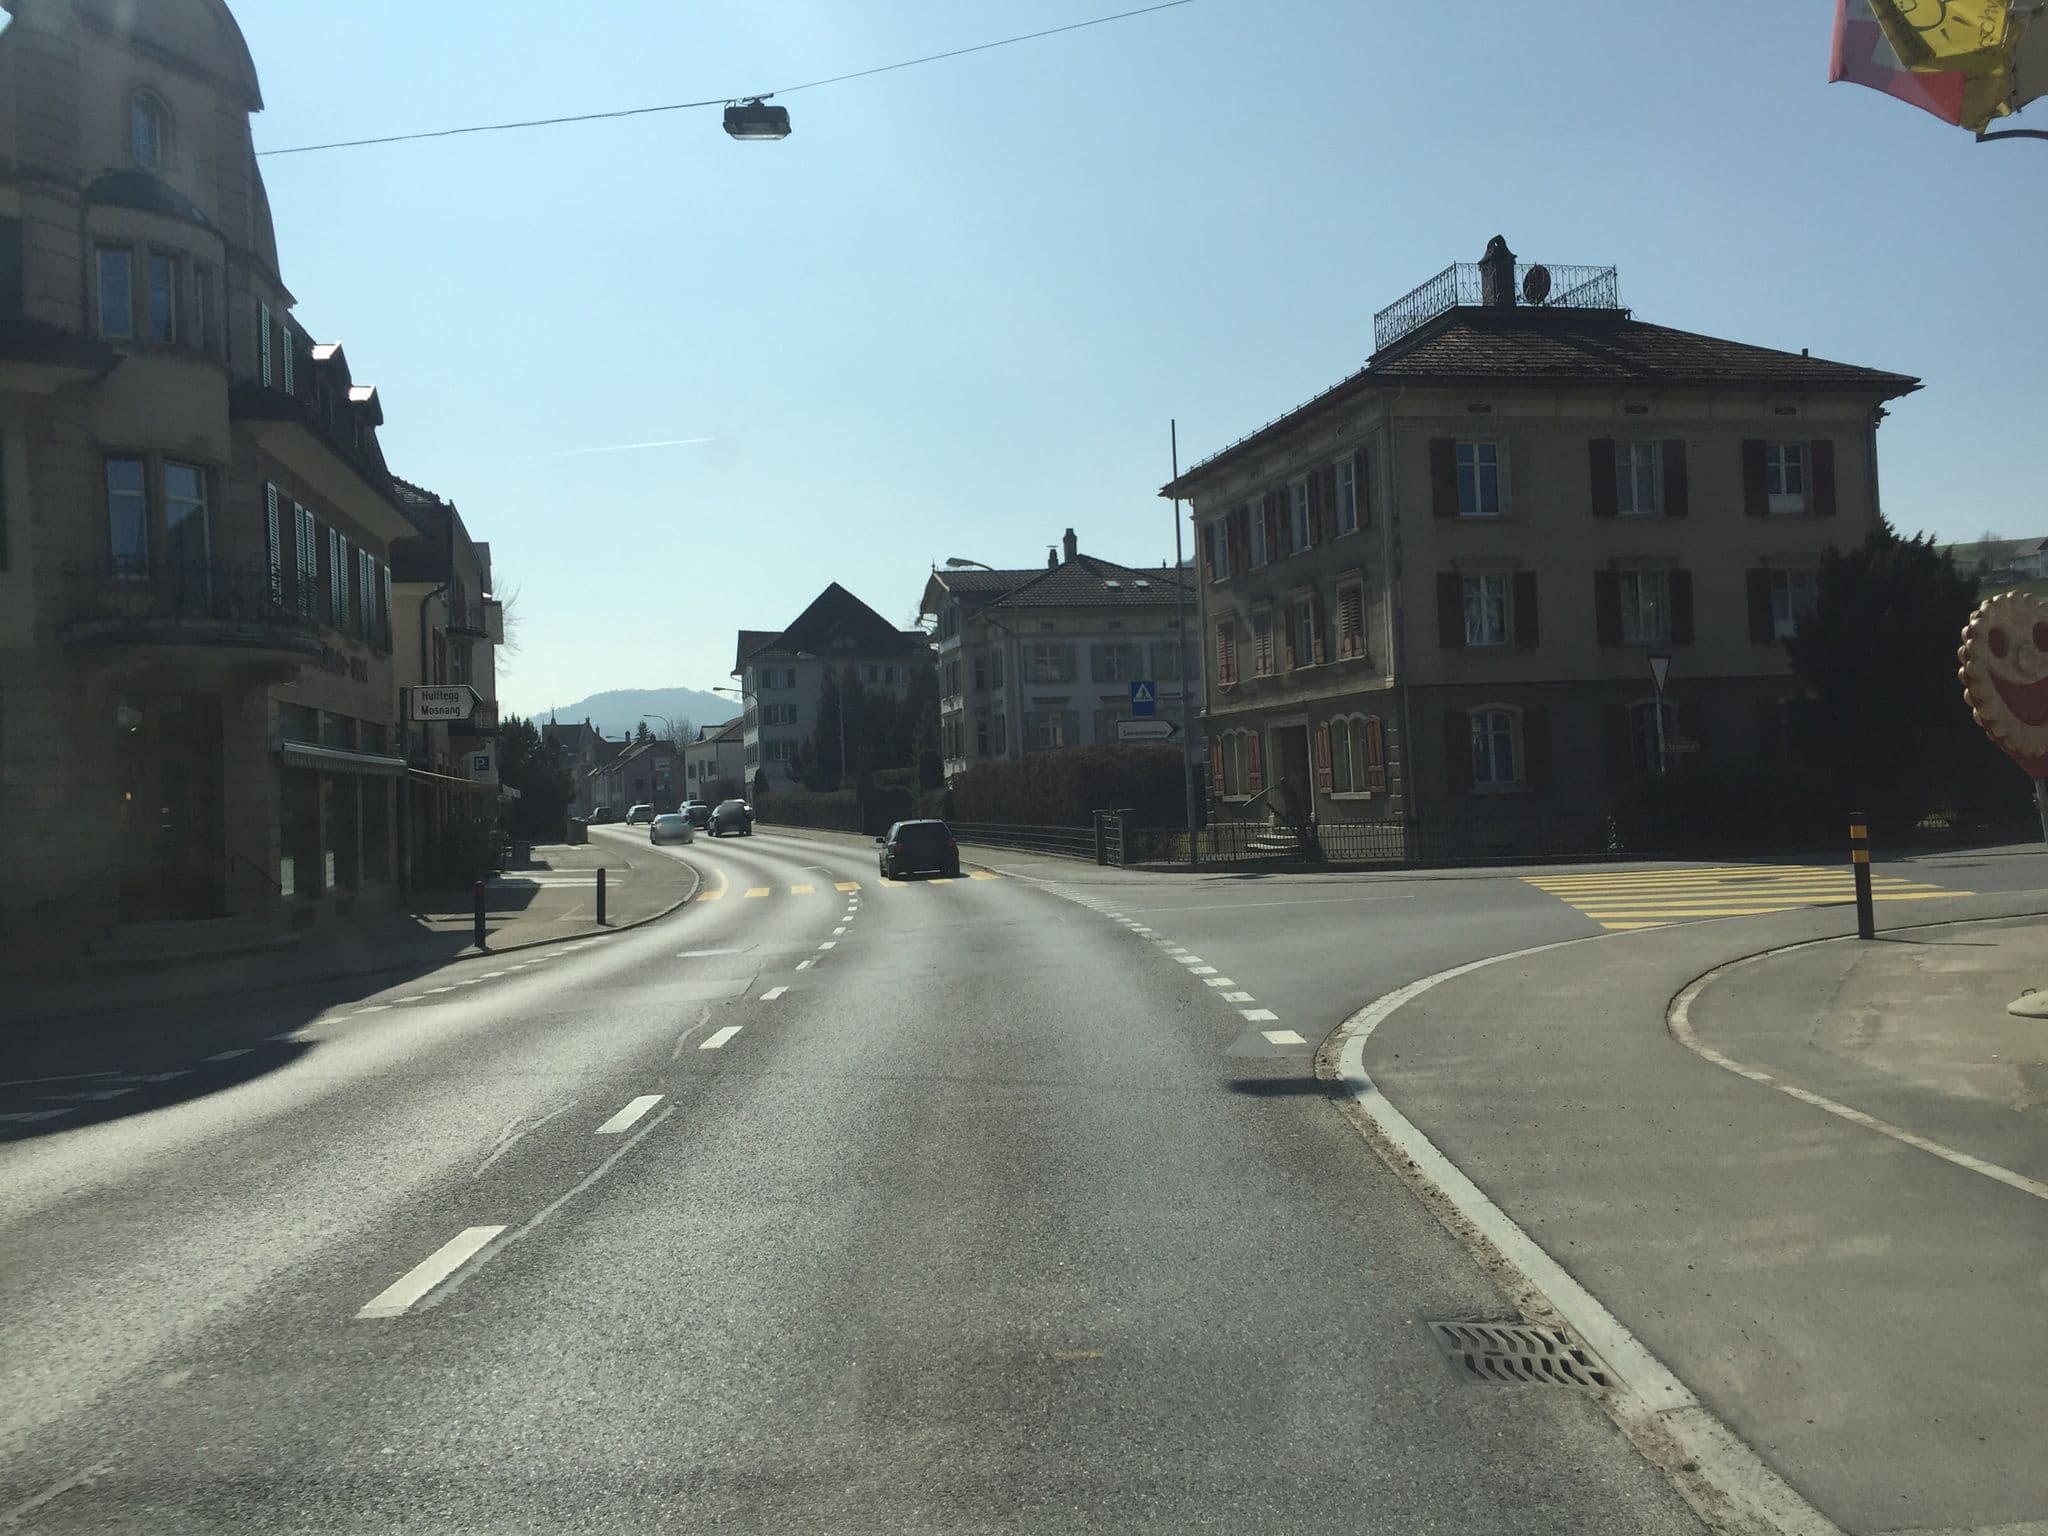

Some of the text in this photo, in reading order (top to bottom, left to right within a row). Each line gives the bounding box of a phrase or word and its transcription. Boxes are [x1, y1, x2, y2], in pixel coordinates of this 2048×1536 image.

[422, 690, 459, 703] Hulftegg
[421, 705, 460, 717] Mosnang
[476, 758, 485, 769] P
